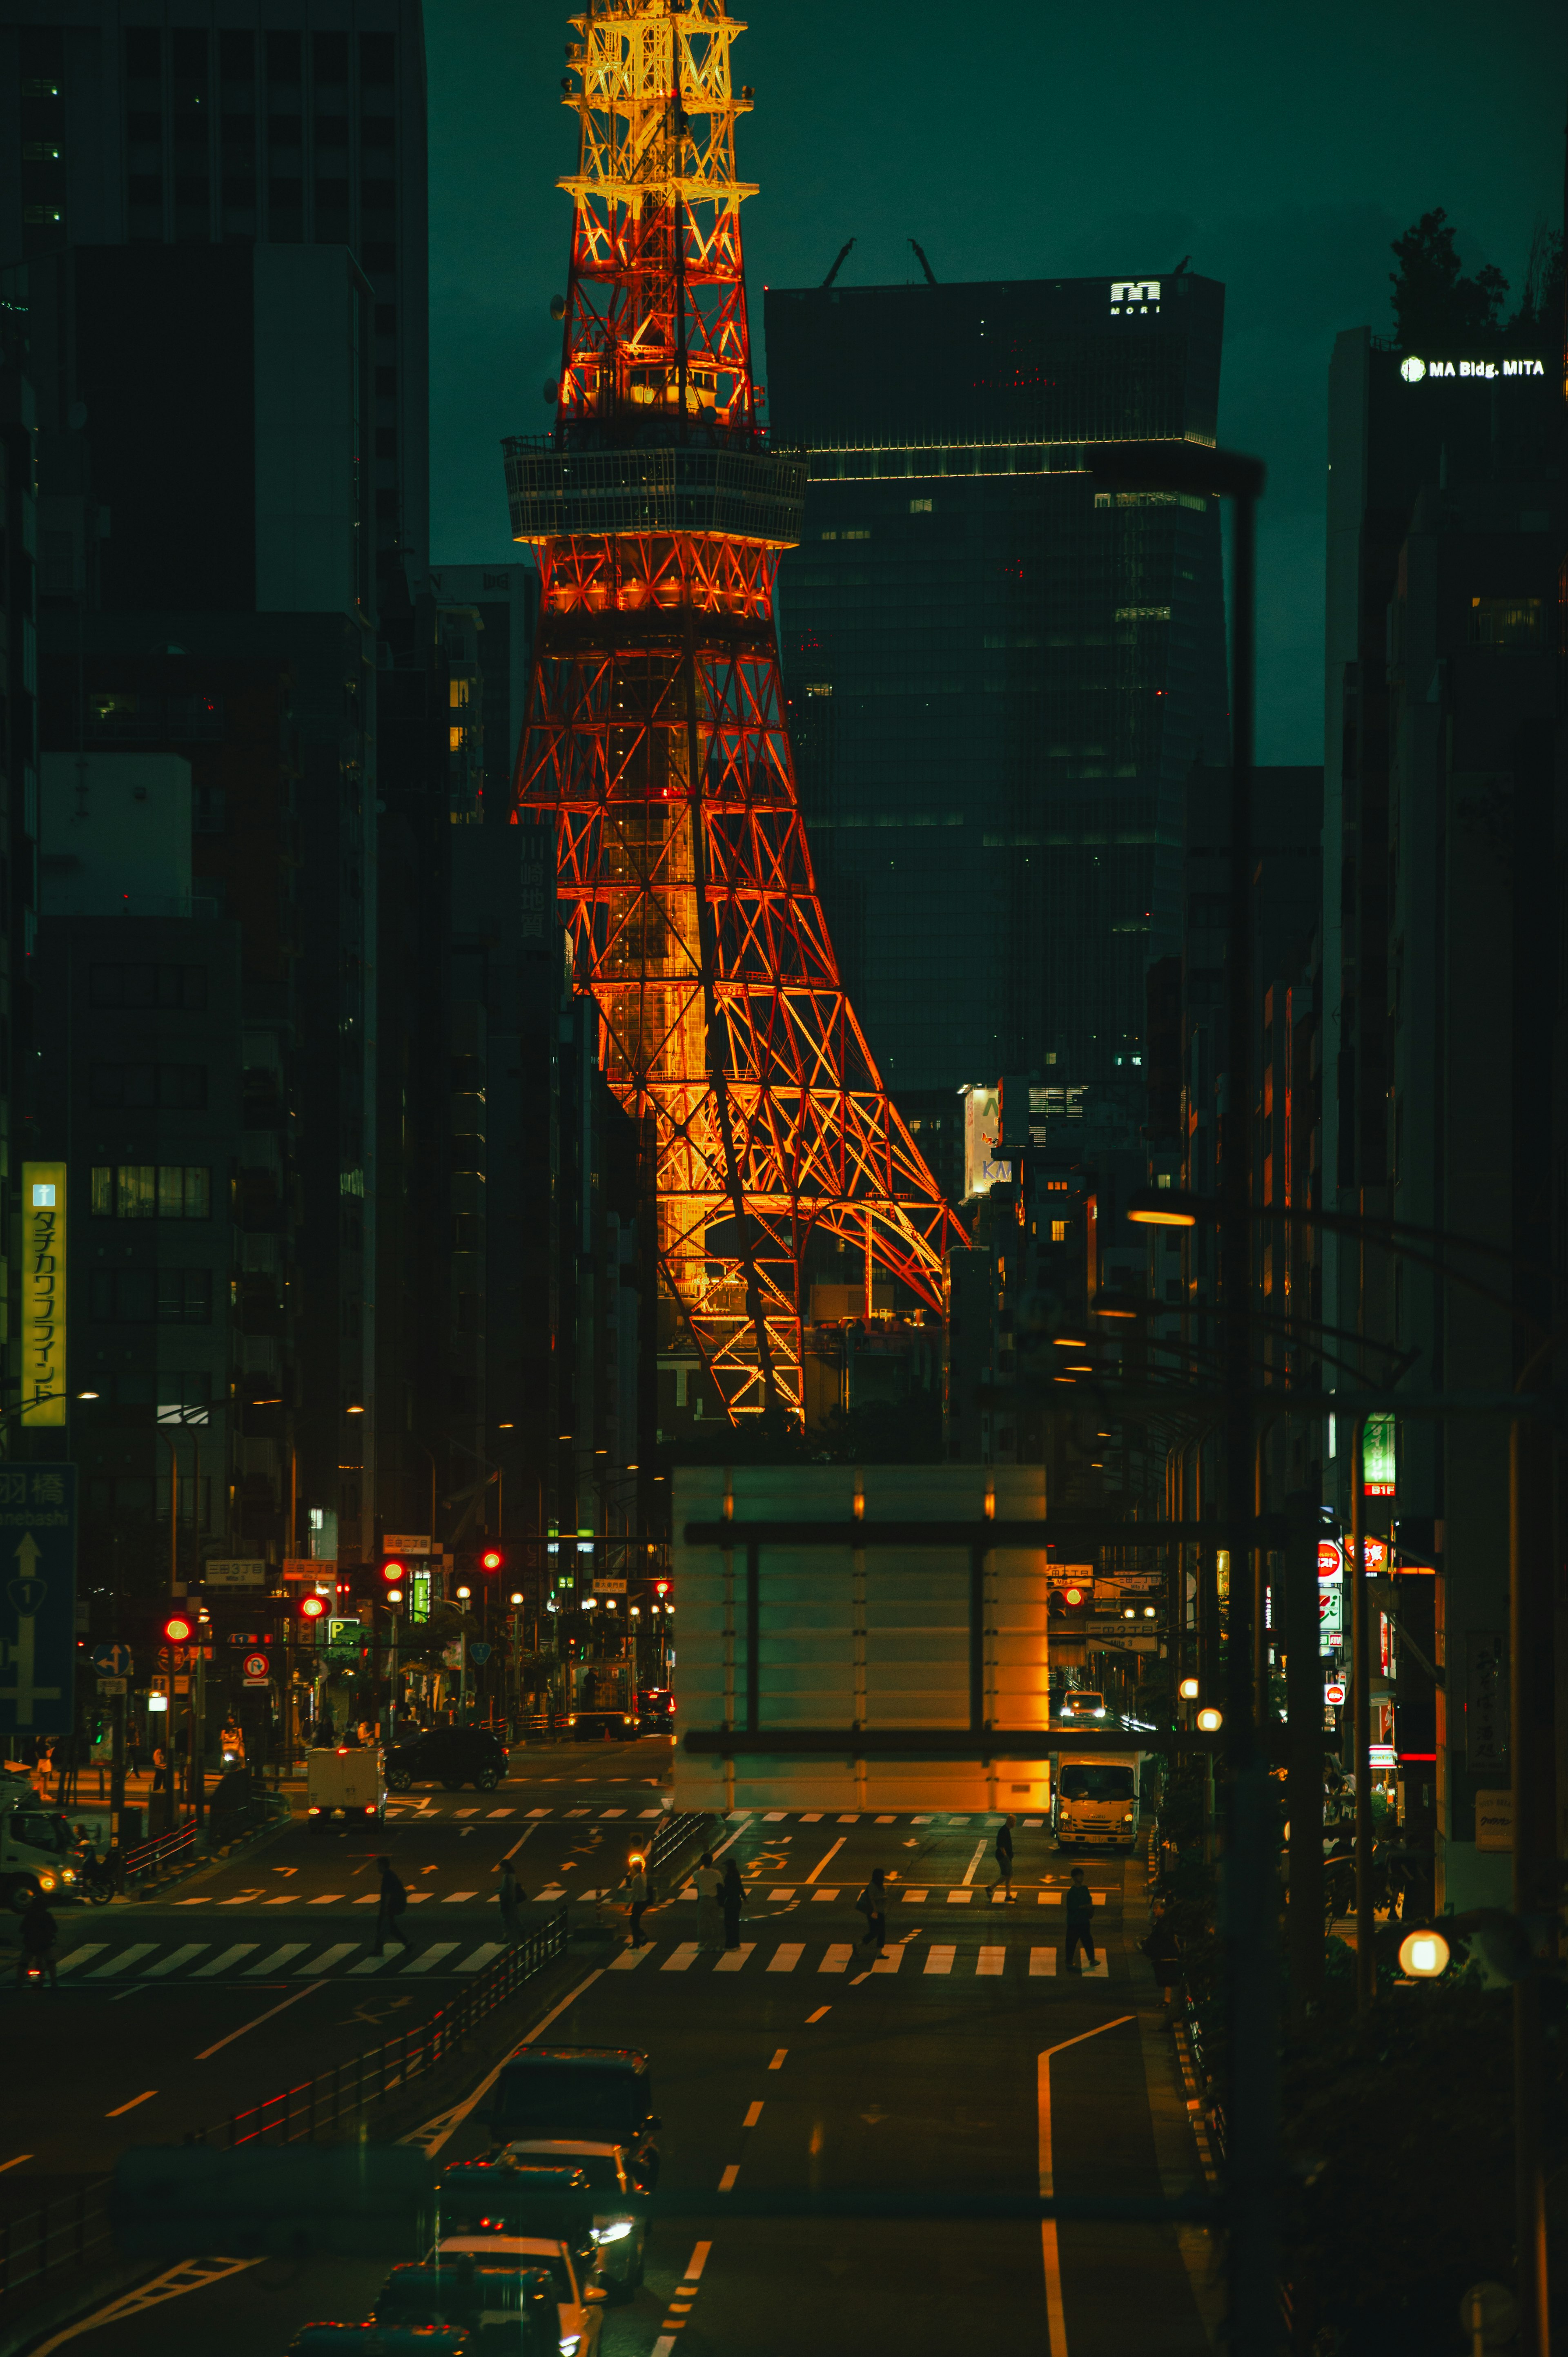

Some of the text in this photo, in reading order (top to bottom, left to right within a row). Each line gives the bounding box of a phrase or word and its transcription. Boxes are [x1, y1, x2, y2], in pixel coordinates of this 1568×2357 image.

[1110, 305, 1160, 315] MORI
[1430, 359, 1544, 378] MA Bldg. MITA
[520, 836, 545, 939] 川崎地質
[33, 1212, 55, 1405] タチカワブラインド
[1371, 1424, 1383, 1482] サイゼリヤ
[1372, 1485, 1394, 1494] B1F
[387, 1539, 427, 1547] 三田二丁目
[209, 1563, 262, 1574] 三田3丁目
[1318, 1558, 1337, 1568] スト
[287, 1564, 334, 1574] 三田二丁目
[21, 1583, 30, 1604] 1
[332, 1622, 344, 1639] P
[1330, 1636, 1341, 1645] ATM
